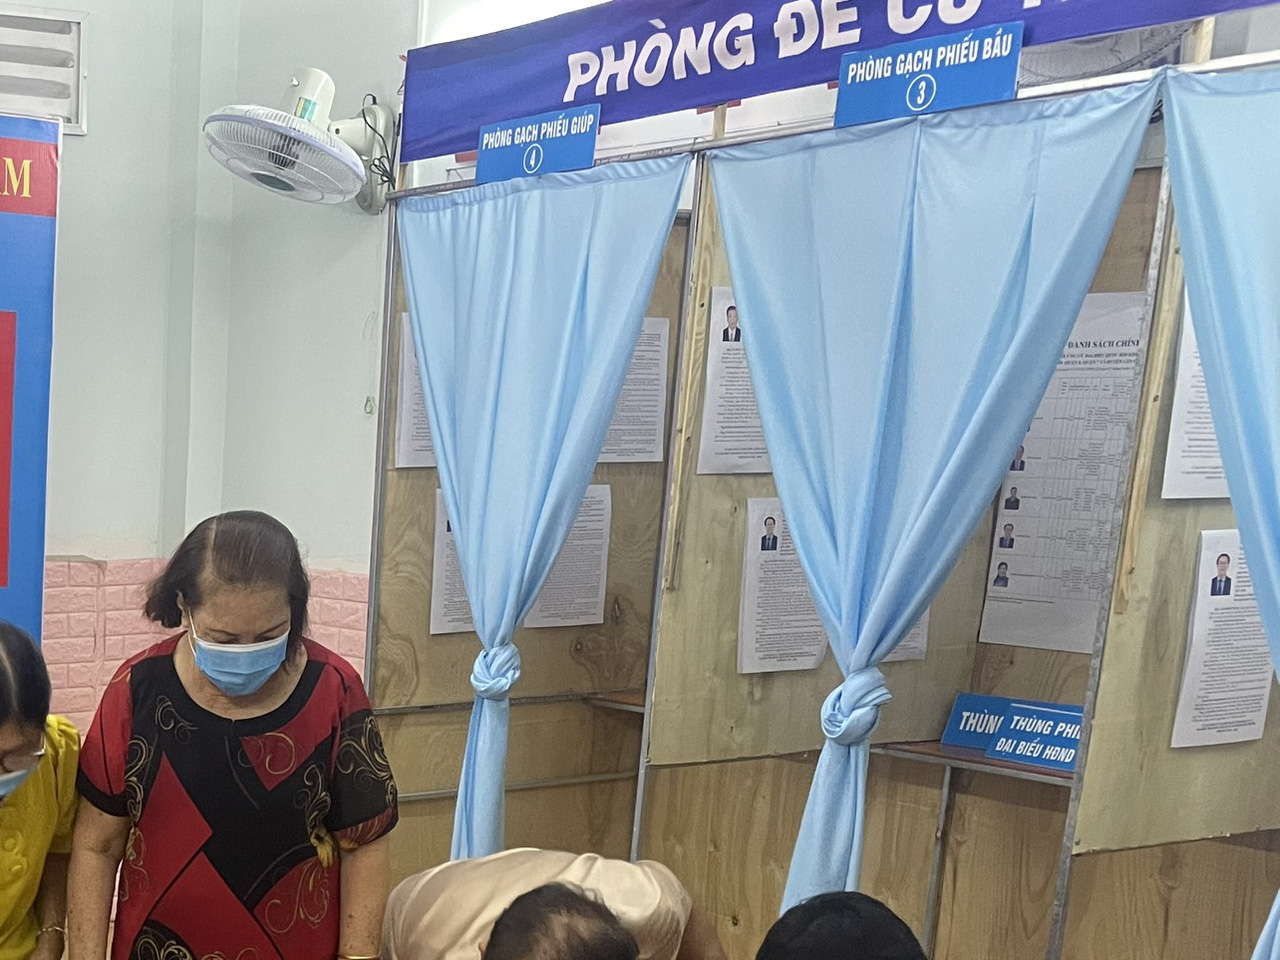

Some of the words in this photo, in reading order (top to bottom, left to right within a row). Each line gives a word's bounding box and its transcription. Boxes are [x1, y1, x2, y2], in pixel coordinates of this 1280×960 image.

[563, 13, 755, 102] PHÒNG
[847, 55, 892, 84] PHÒNG
[895, 49, 933, 78] GẠCH
[936, 29, 979, 68] PHIẾU
[982, 28, 1013, 59] BẦU
[916, 80, 926, 105] 3
[482, 127, 512, 150] PHÒNG
[514, 124, 539, 147] GẠCH
[540, 113, 569, 140] PHIẾU
[570, 111, 594, 135] GIÚP
[529, 149, 536, 168] 4
[1010, 715, 1054, 735] THÙNG
[995, 738, 1017, 755] ĐẠI
[1042, 745, 1076, 763] HĐND
